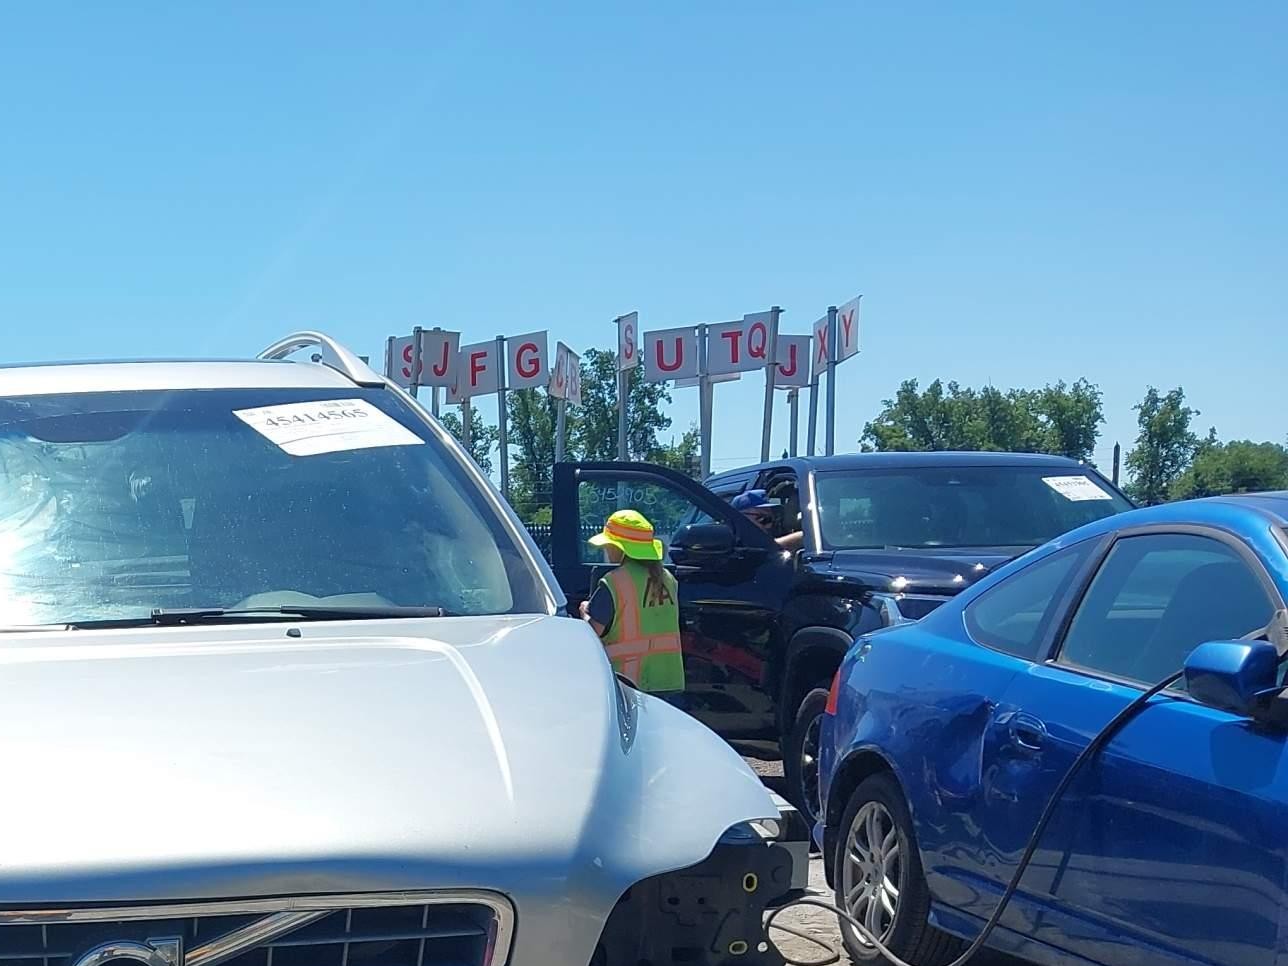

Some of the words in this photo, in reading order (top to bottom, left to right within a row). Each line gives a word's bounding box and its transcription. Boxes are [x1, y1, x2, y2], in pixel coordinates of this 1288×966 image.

[624, 324, 634, 360] S
[748, 322, 767, 358] Q
[842, 309, 854, 347] Y
[433, 341, 449, 376] J
[516, 343, 540, 378] G
[656, 337, 683, 371] U
[721, 331, 742, 363] T
[779, 345, 797, 377] J
[471, 352, 487, 386] F
